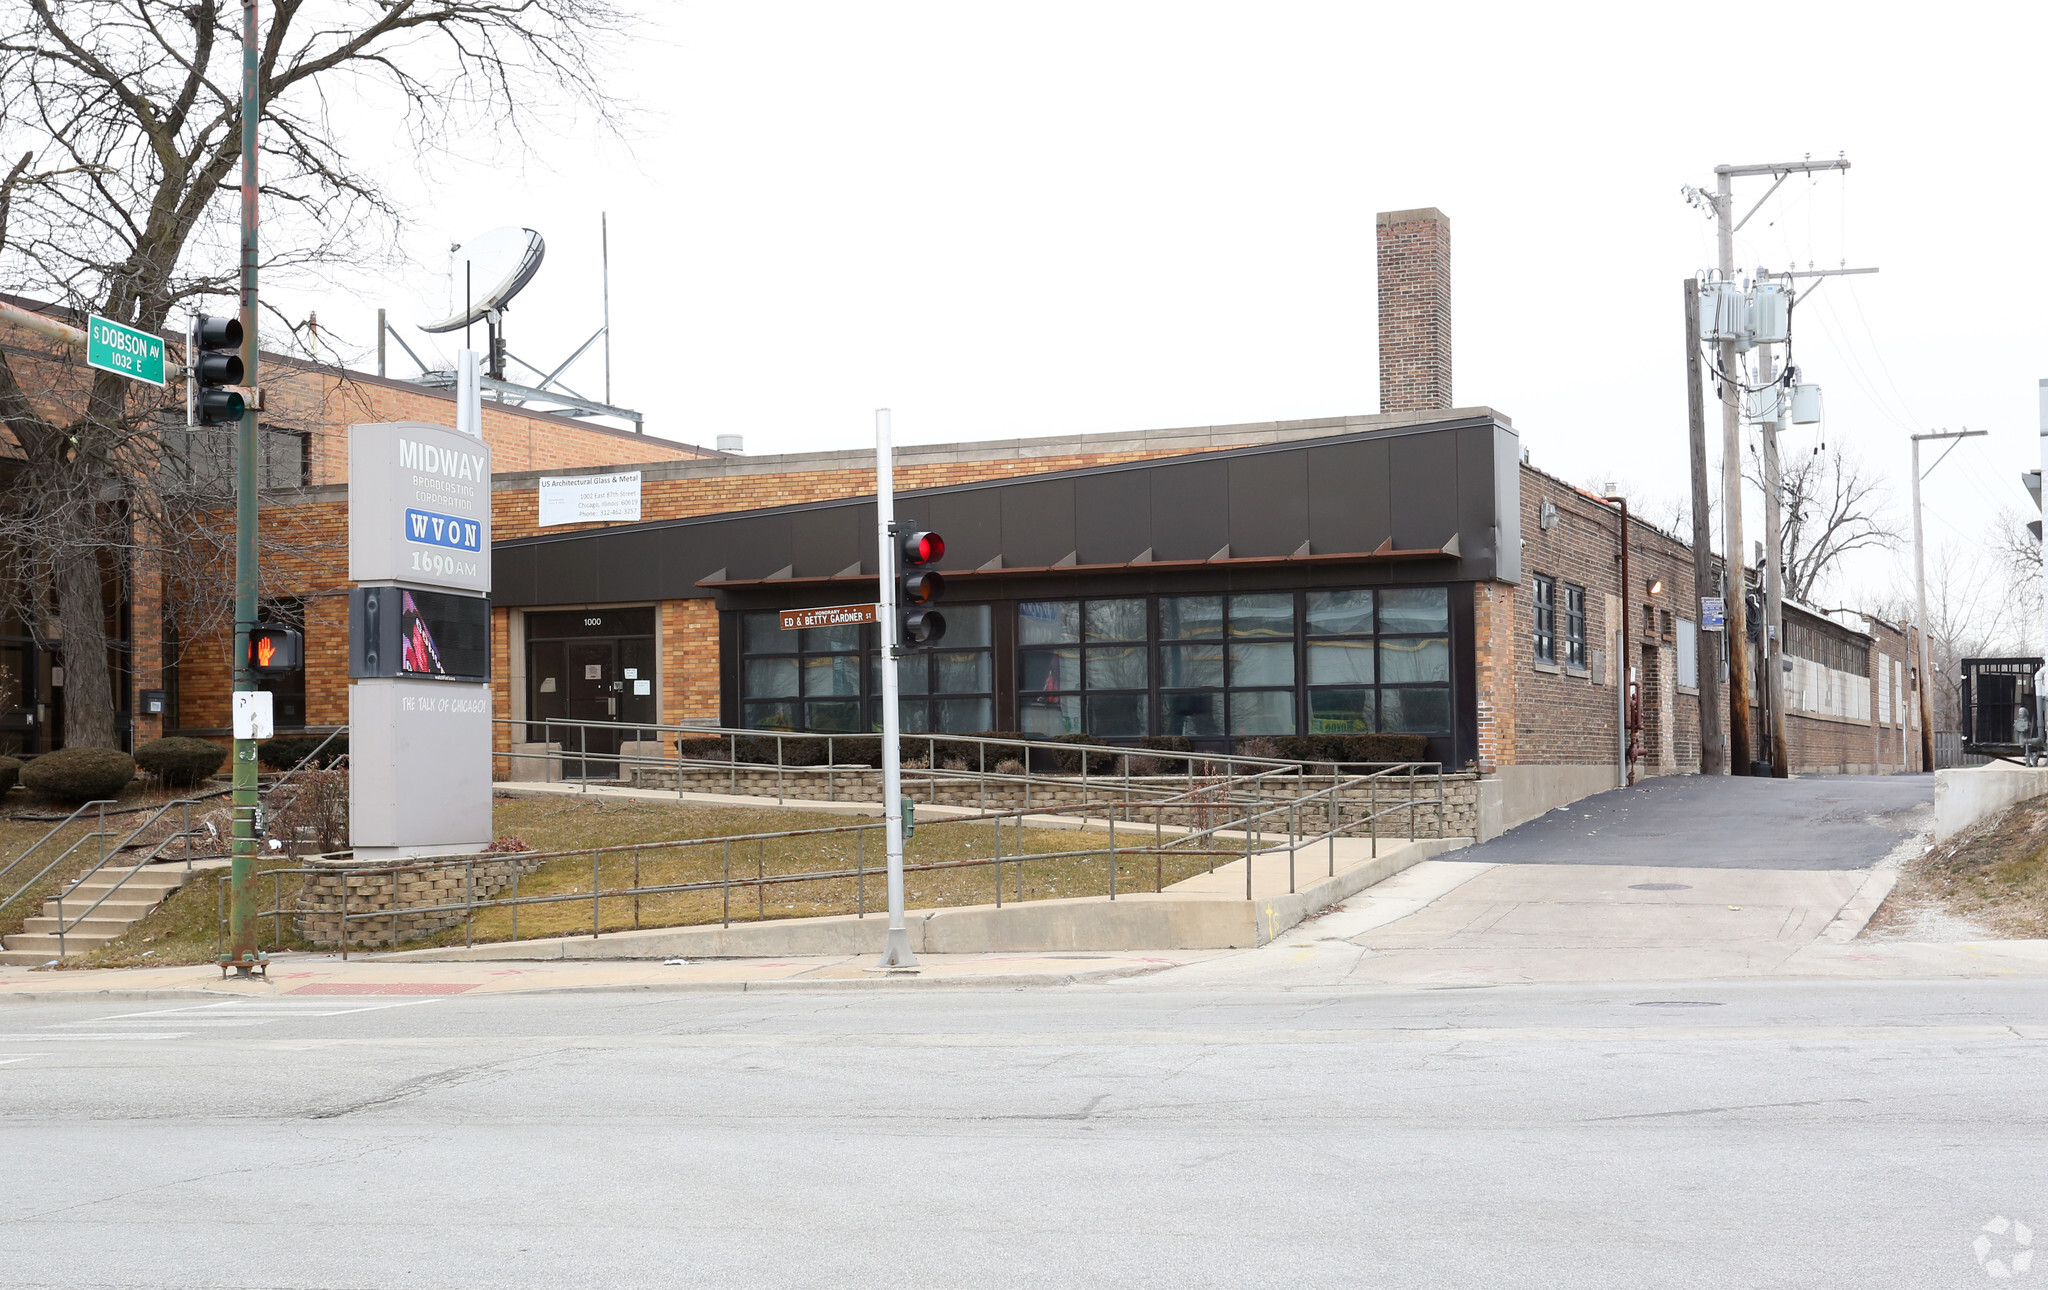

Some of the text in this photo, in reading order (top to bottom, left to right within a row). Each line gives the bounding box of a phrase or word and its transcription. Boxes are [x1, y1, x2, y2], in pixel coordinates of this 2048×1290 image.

[93, 326, 160, 358] S DOBSON AV
[112, 352, 142, 373] 1032 E
[399, 438, 485, 483] MIDWAY
[413, 475, 474, 497] BROADCASTING
[541, 480, 551, 488] US
[551, 479, 593, 487] Architectural
[612, 475, 618, 483] &
[619, 474, 639, 483] Metal
[416, 490, 472, 511] CORPORATION
[578, 501, 601, 509] Chicago,
[410, 513, 477, 548] WVON
[583, 617, 602, 626] 1000
[784, 617, 794, 627] ED
[796, 617, 802, 626] &
[805, 615, 828, 625] BETTY
[830, 612, 863, 624] GARDNER
[402, 697, 487, 713] THE TALK OF CHICAGO!
